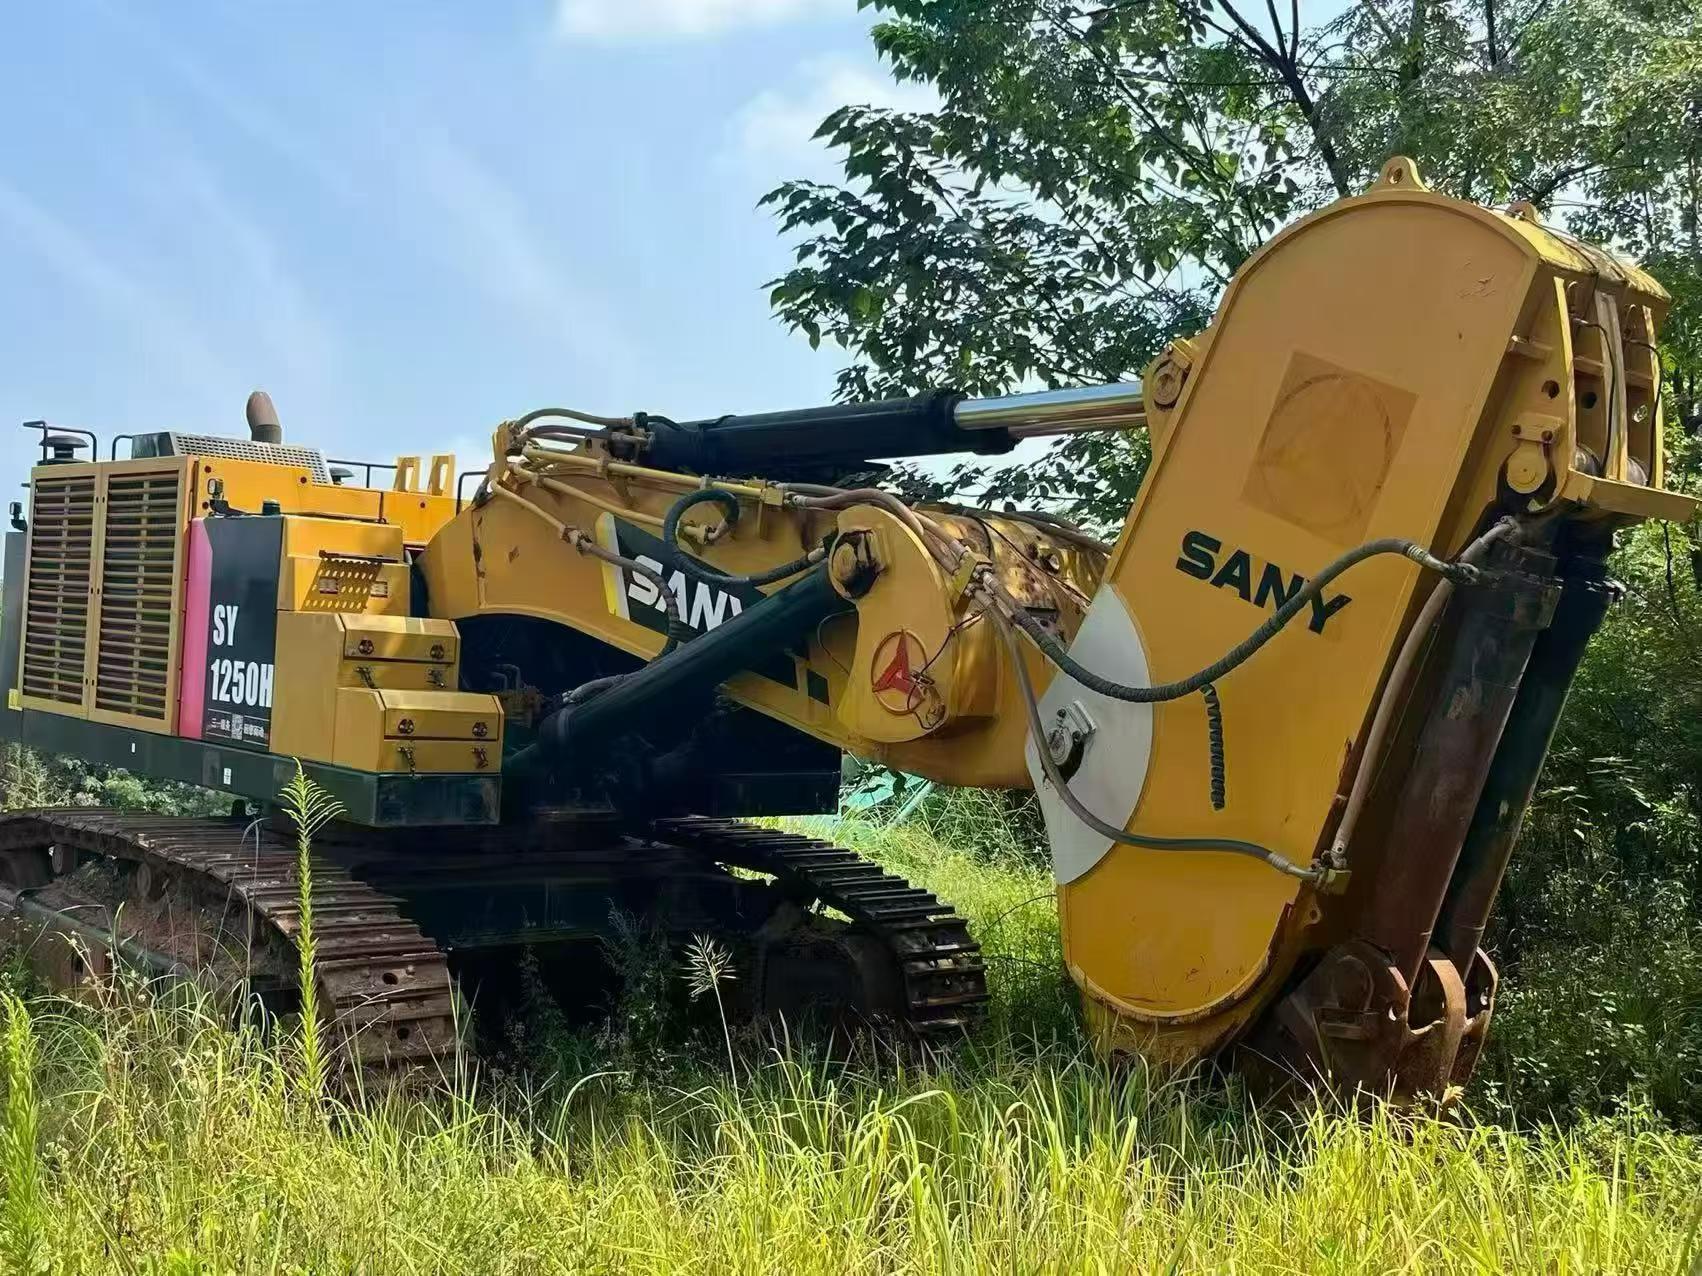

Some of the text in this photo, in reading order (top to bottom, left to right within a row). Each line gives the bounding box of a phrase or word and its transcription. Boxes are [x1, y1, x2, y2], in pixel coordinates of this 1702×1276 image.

[1176, 530, 1352, 635] SANY
[212, 604, 239, 646] SY
[210, 659, 274, 708] 1250H
